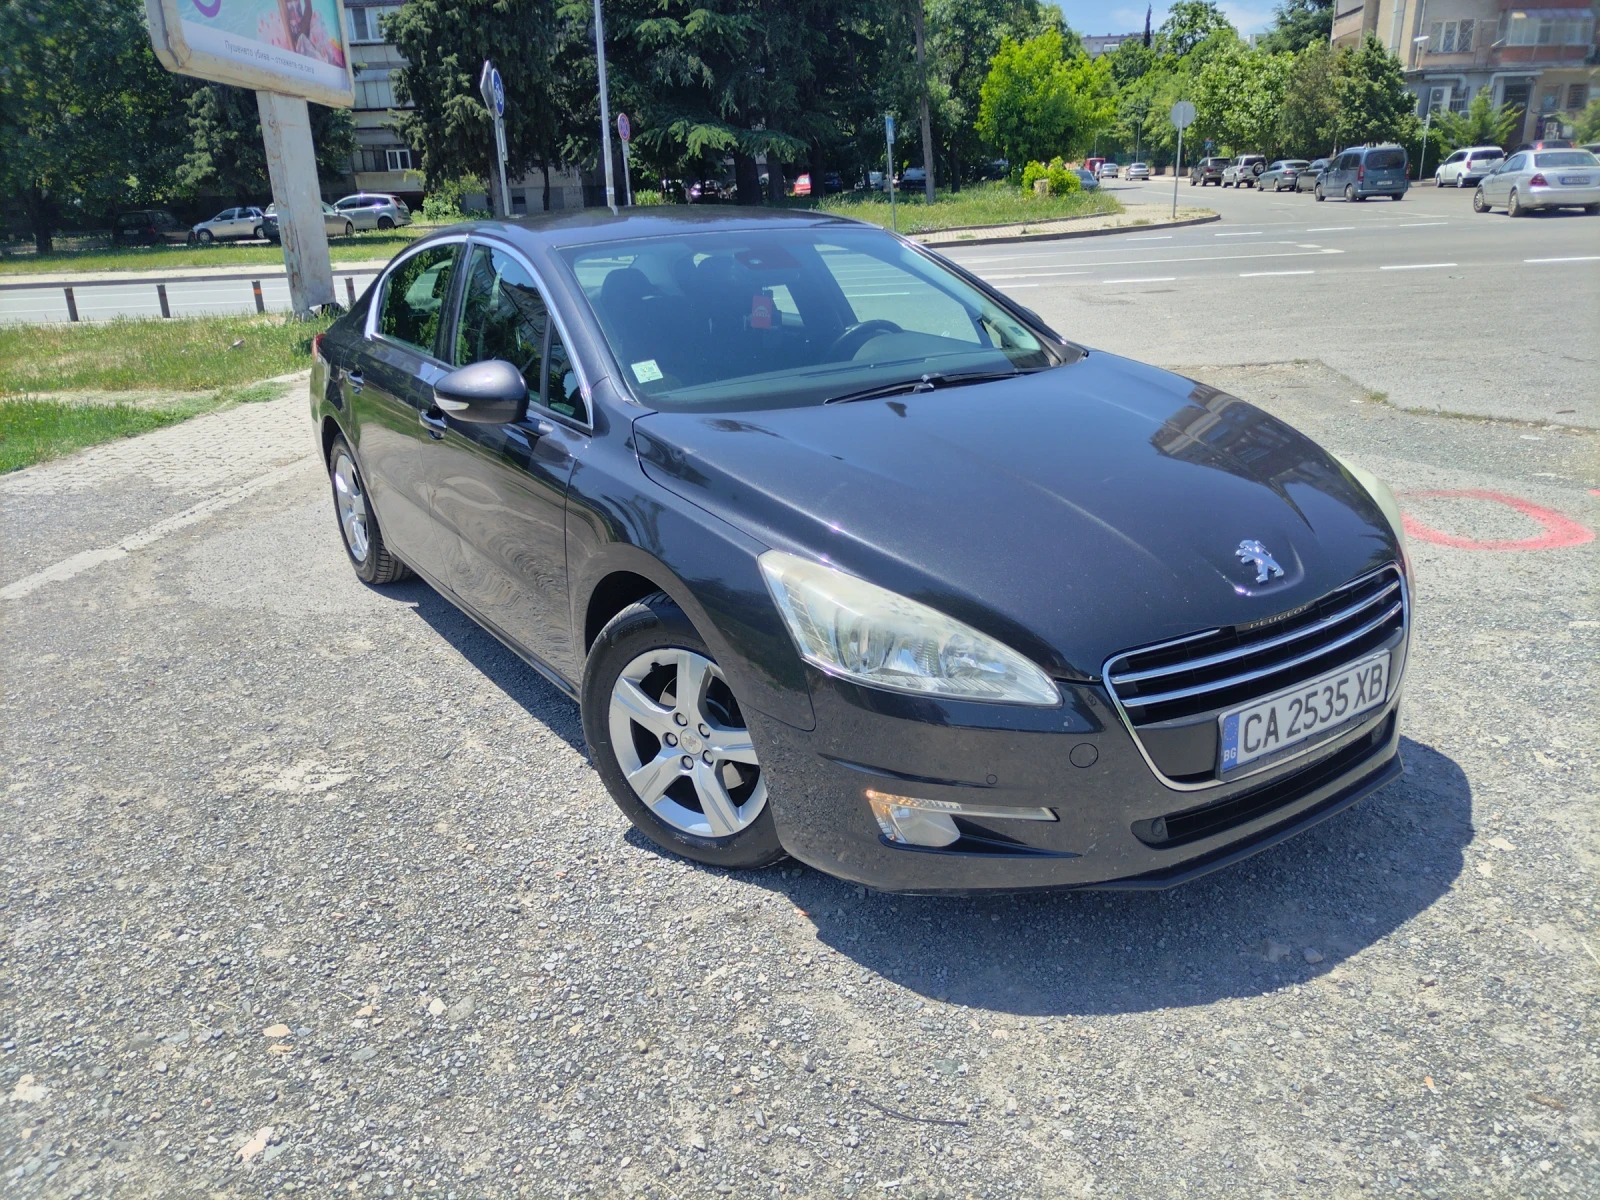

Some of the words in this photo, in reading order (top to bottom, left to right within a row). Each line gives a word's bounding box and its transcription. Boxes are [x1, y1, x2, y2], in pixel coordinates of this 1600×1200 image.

[224, 40, 253, 56] Пушенето
[254, 49, 270, 61] убива
[297, 63, 304, 71] се
[1250, 605, 1307, 629] PEUGEOT
[1243, 707, 1280, 753] CA
[1286, 677, 1350, 739] 2535
[1353, 663, 1383, 709] XB
[1223, 747, 1237, 762] BG
